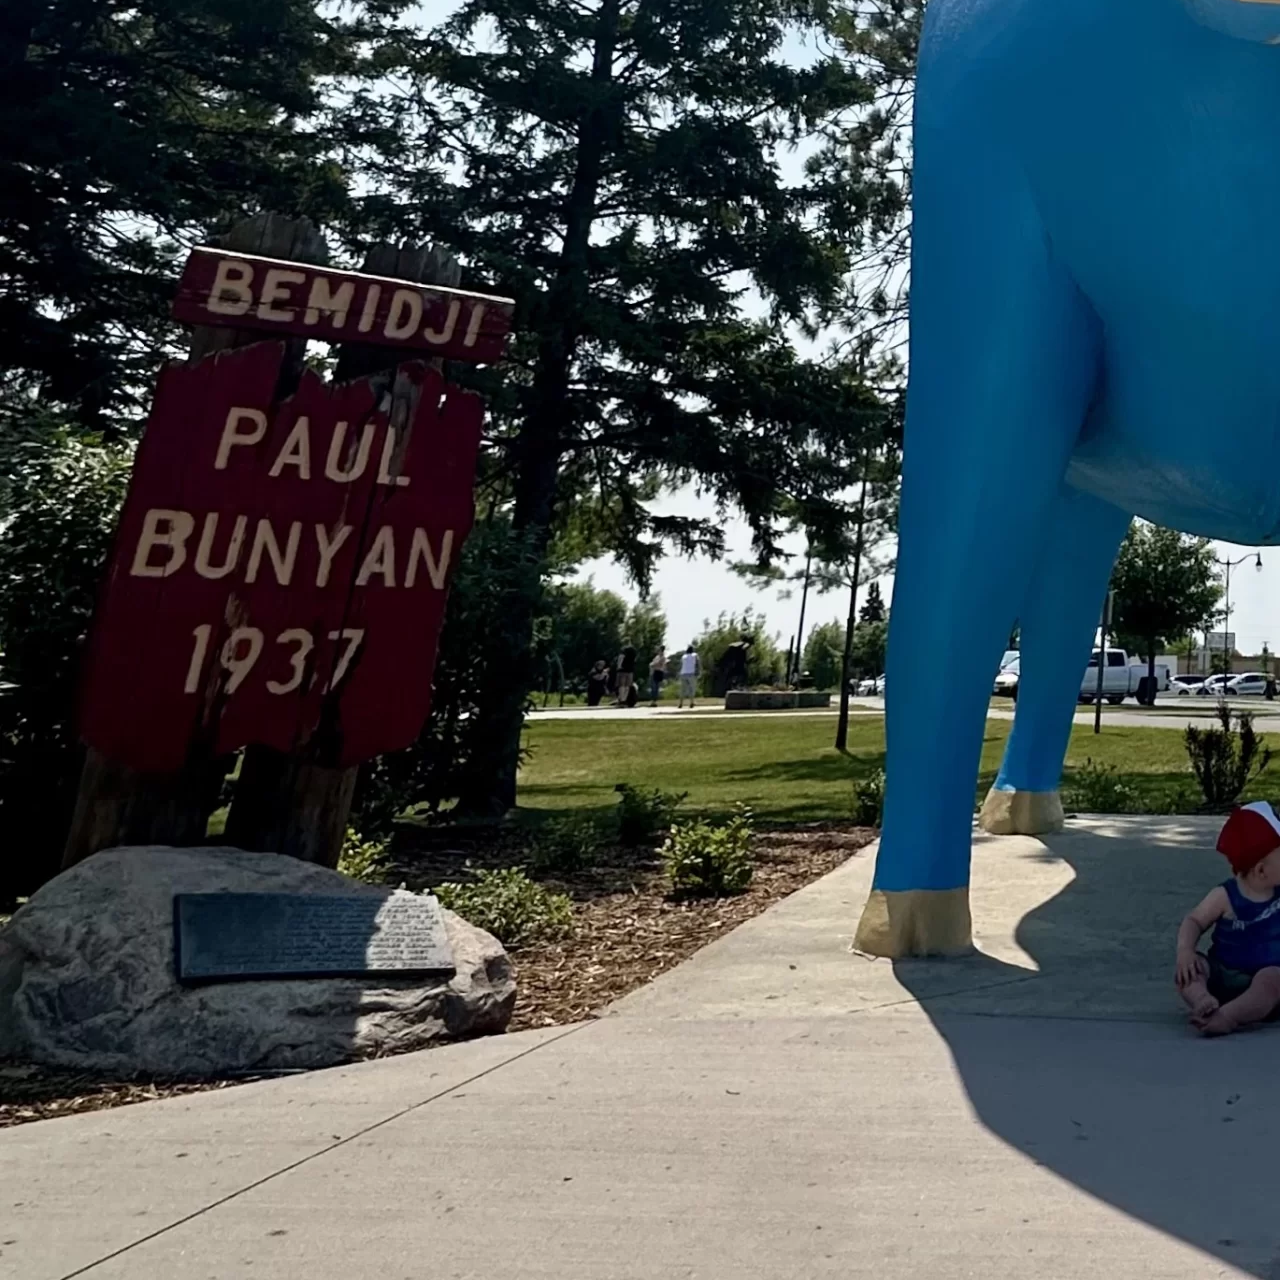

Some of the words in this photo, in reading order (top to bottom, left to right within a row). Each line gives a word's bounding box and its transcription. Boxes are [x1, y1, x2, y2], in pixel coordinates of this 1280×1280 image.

[207, 259, 485, 347] BEMIDJI
[214, 406, 411, 487] PAUL
[130, 508, 454, 590] BUNYAN
[184, 623, 365, 695] 1937
